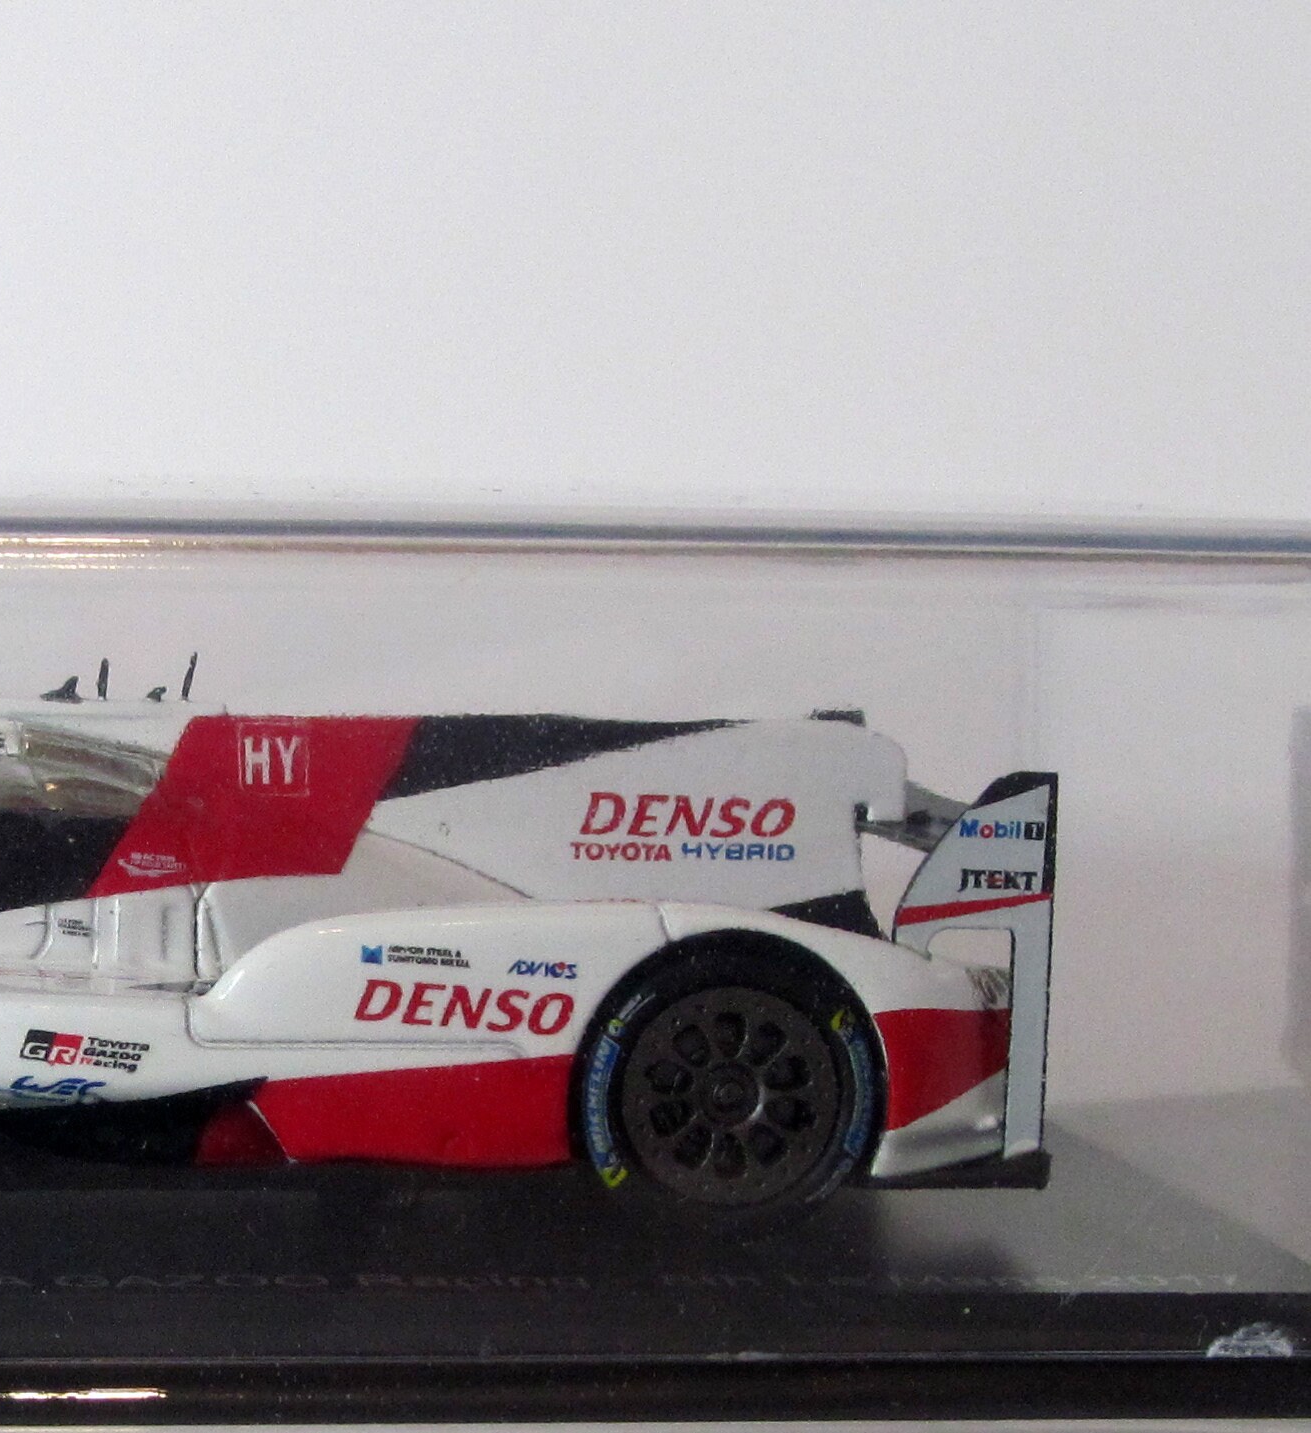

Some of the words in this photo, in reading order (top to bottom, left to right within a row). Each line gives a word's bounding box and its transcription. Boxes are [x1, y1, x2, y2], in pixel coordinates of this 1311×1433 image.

[244, 735, 300, 785] HY
[579, 791, 796, 838] DENSO
[959, 819, 1022, 839] Mobil
[570, 841, 673, 862] TOYOTA
[680, 842, 796, 862] HYBRID
[957, 868, 1038, 893] JTEKT
[354, 978, 574, 1036] DENSO
[20, 1041, 76, 1066] GR
[82, 1046, 143, 1062] GAZOO
[87, 1036, 151, 1052] TOYOTA
[79, 1056, 138, 1074] Racing
